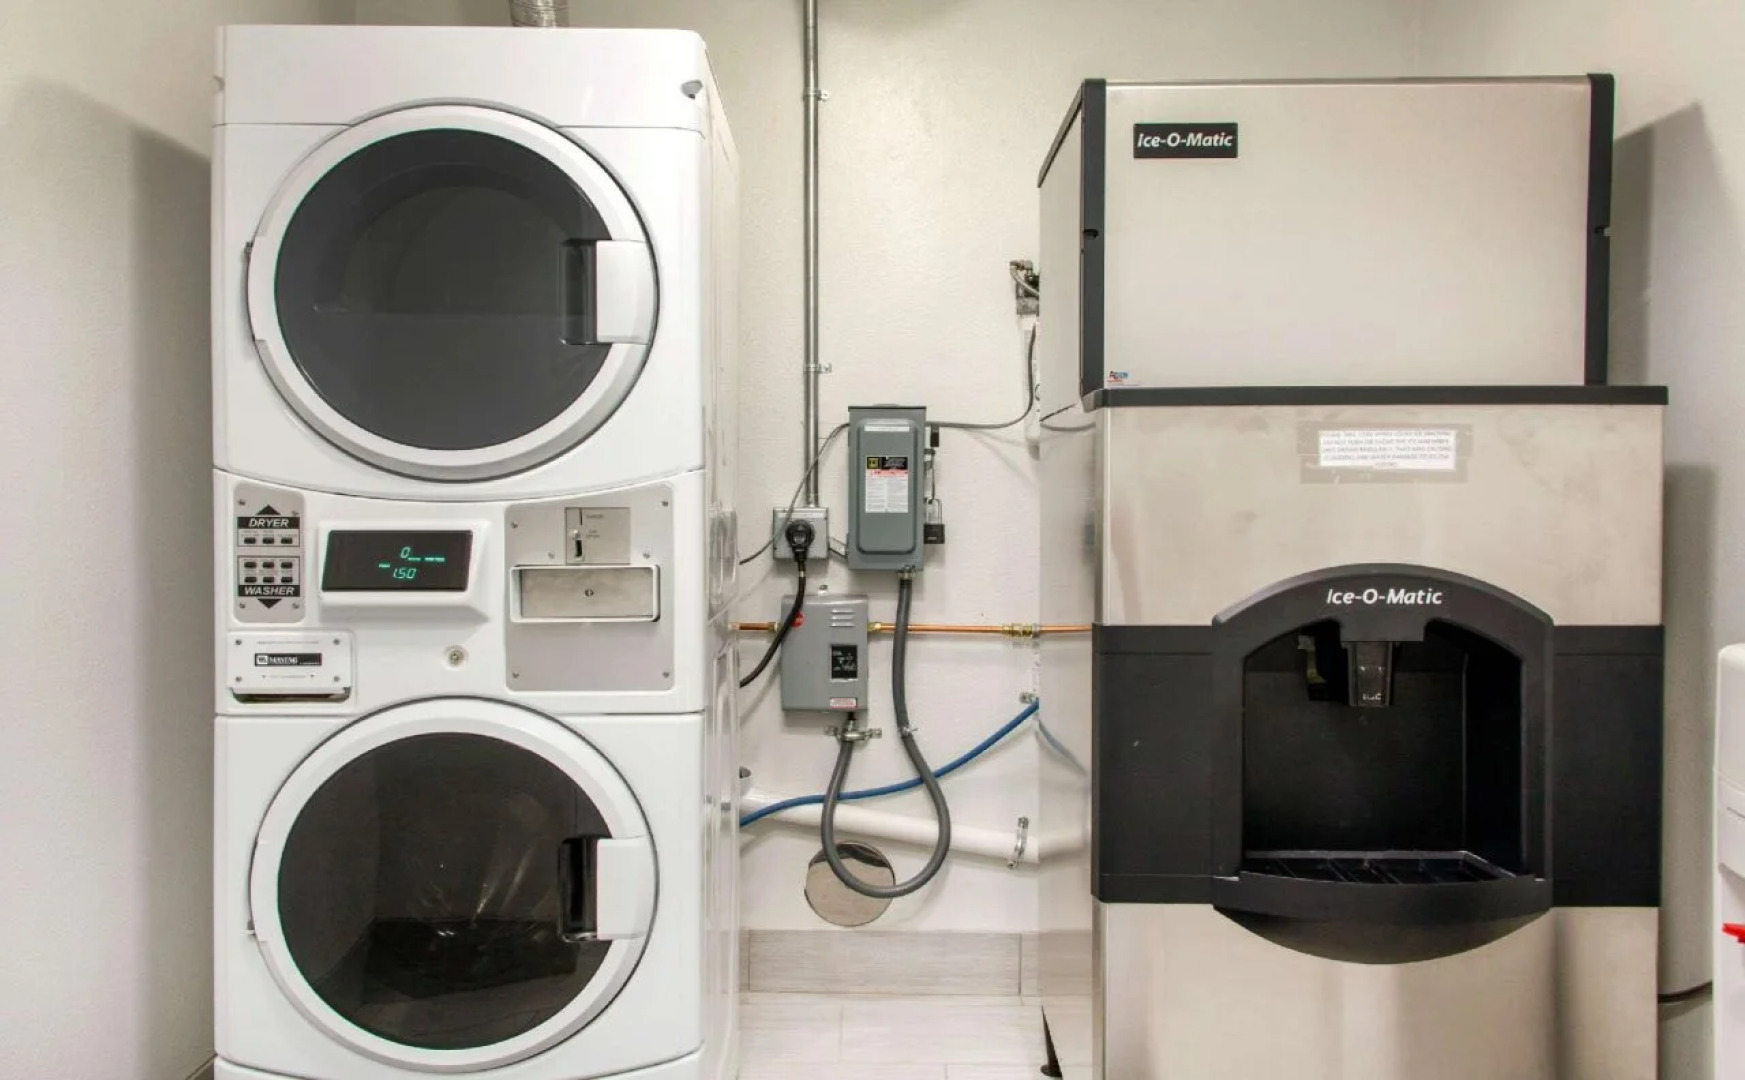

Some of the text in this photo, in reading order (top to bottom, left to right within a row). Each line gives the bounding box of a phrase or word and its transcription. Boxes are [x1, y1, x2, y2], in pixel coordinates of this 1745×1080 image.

[1136, 132, 1234, 148] Ice-O-Matic
[248, 517, 290, 528] DRYER
[243, 585, 296, 596] WASHER
[1325, 587, 1444, 606] Ice-O-Matic
